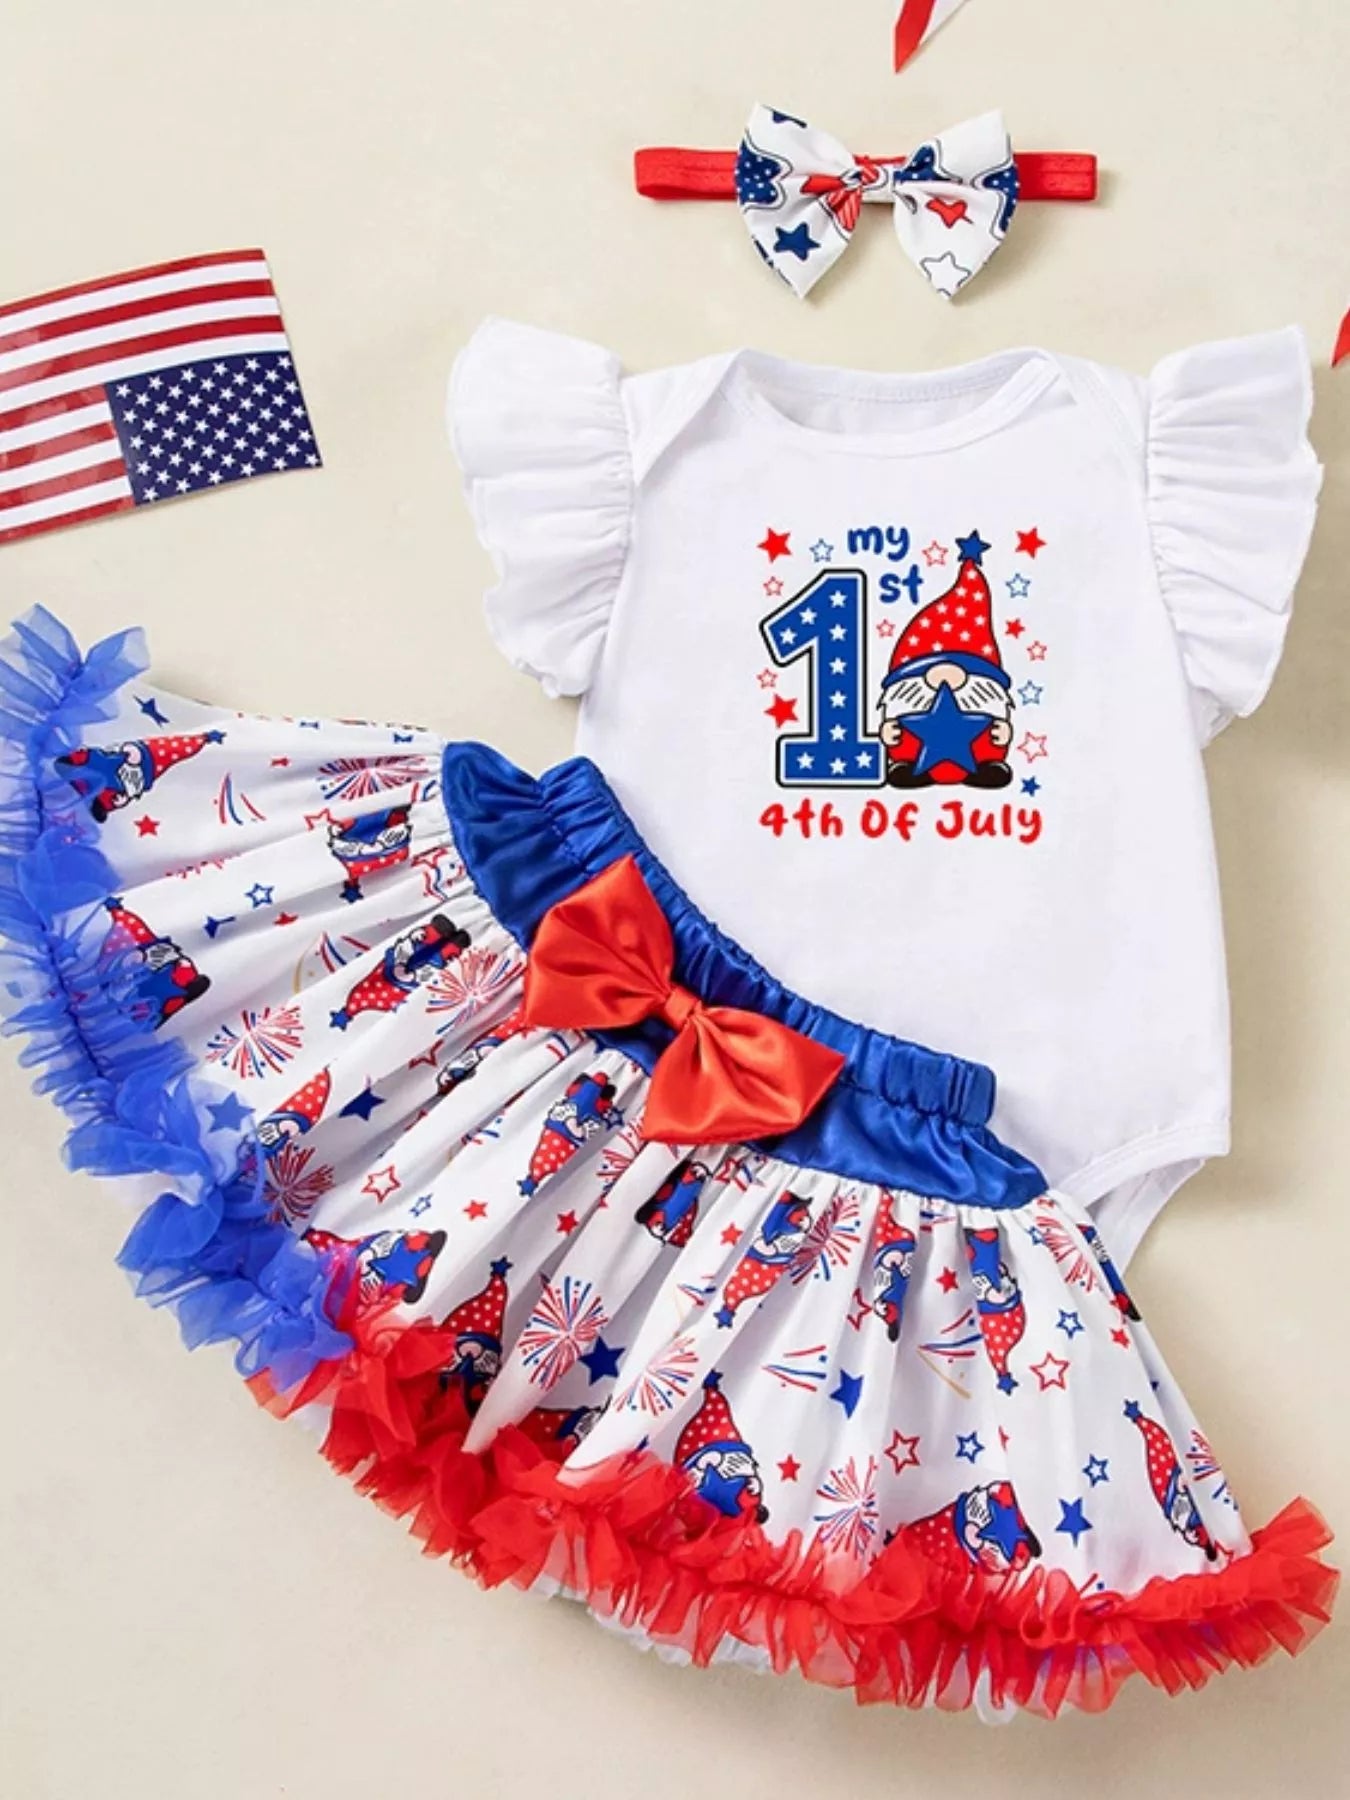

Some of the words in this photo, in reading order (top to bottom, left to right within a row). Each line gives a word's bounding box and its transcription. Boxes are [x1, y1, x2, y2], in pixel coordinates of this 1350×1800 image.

[847, 526, 910, 561] my
[759, 798, 843, 839] 4th
[860, 799, 919, 842] Of
[935, 801, 1043, 844] July
